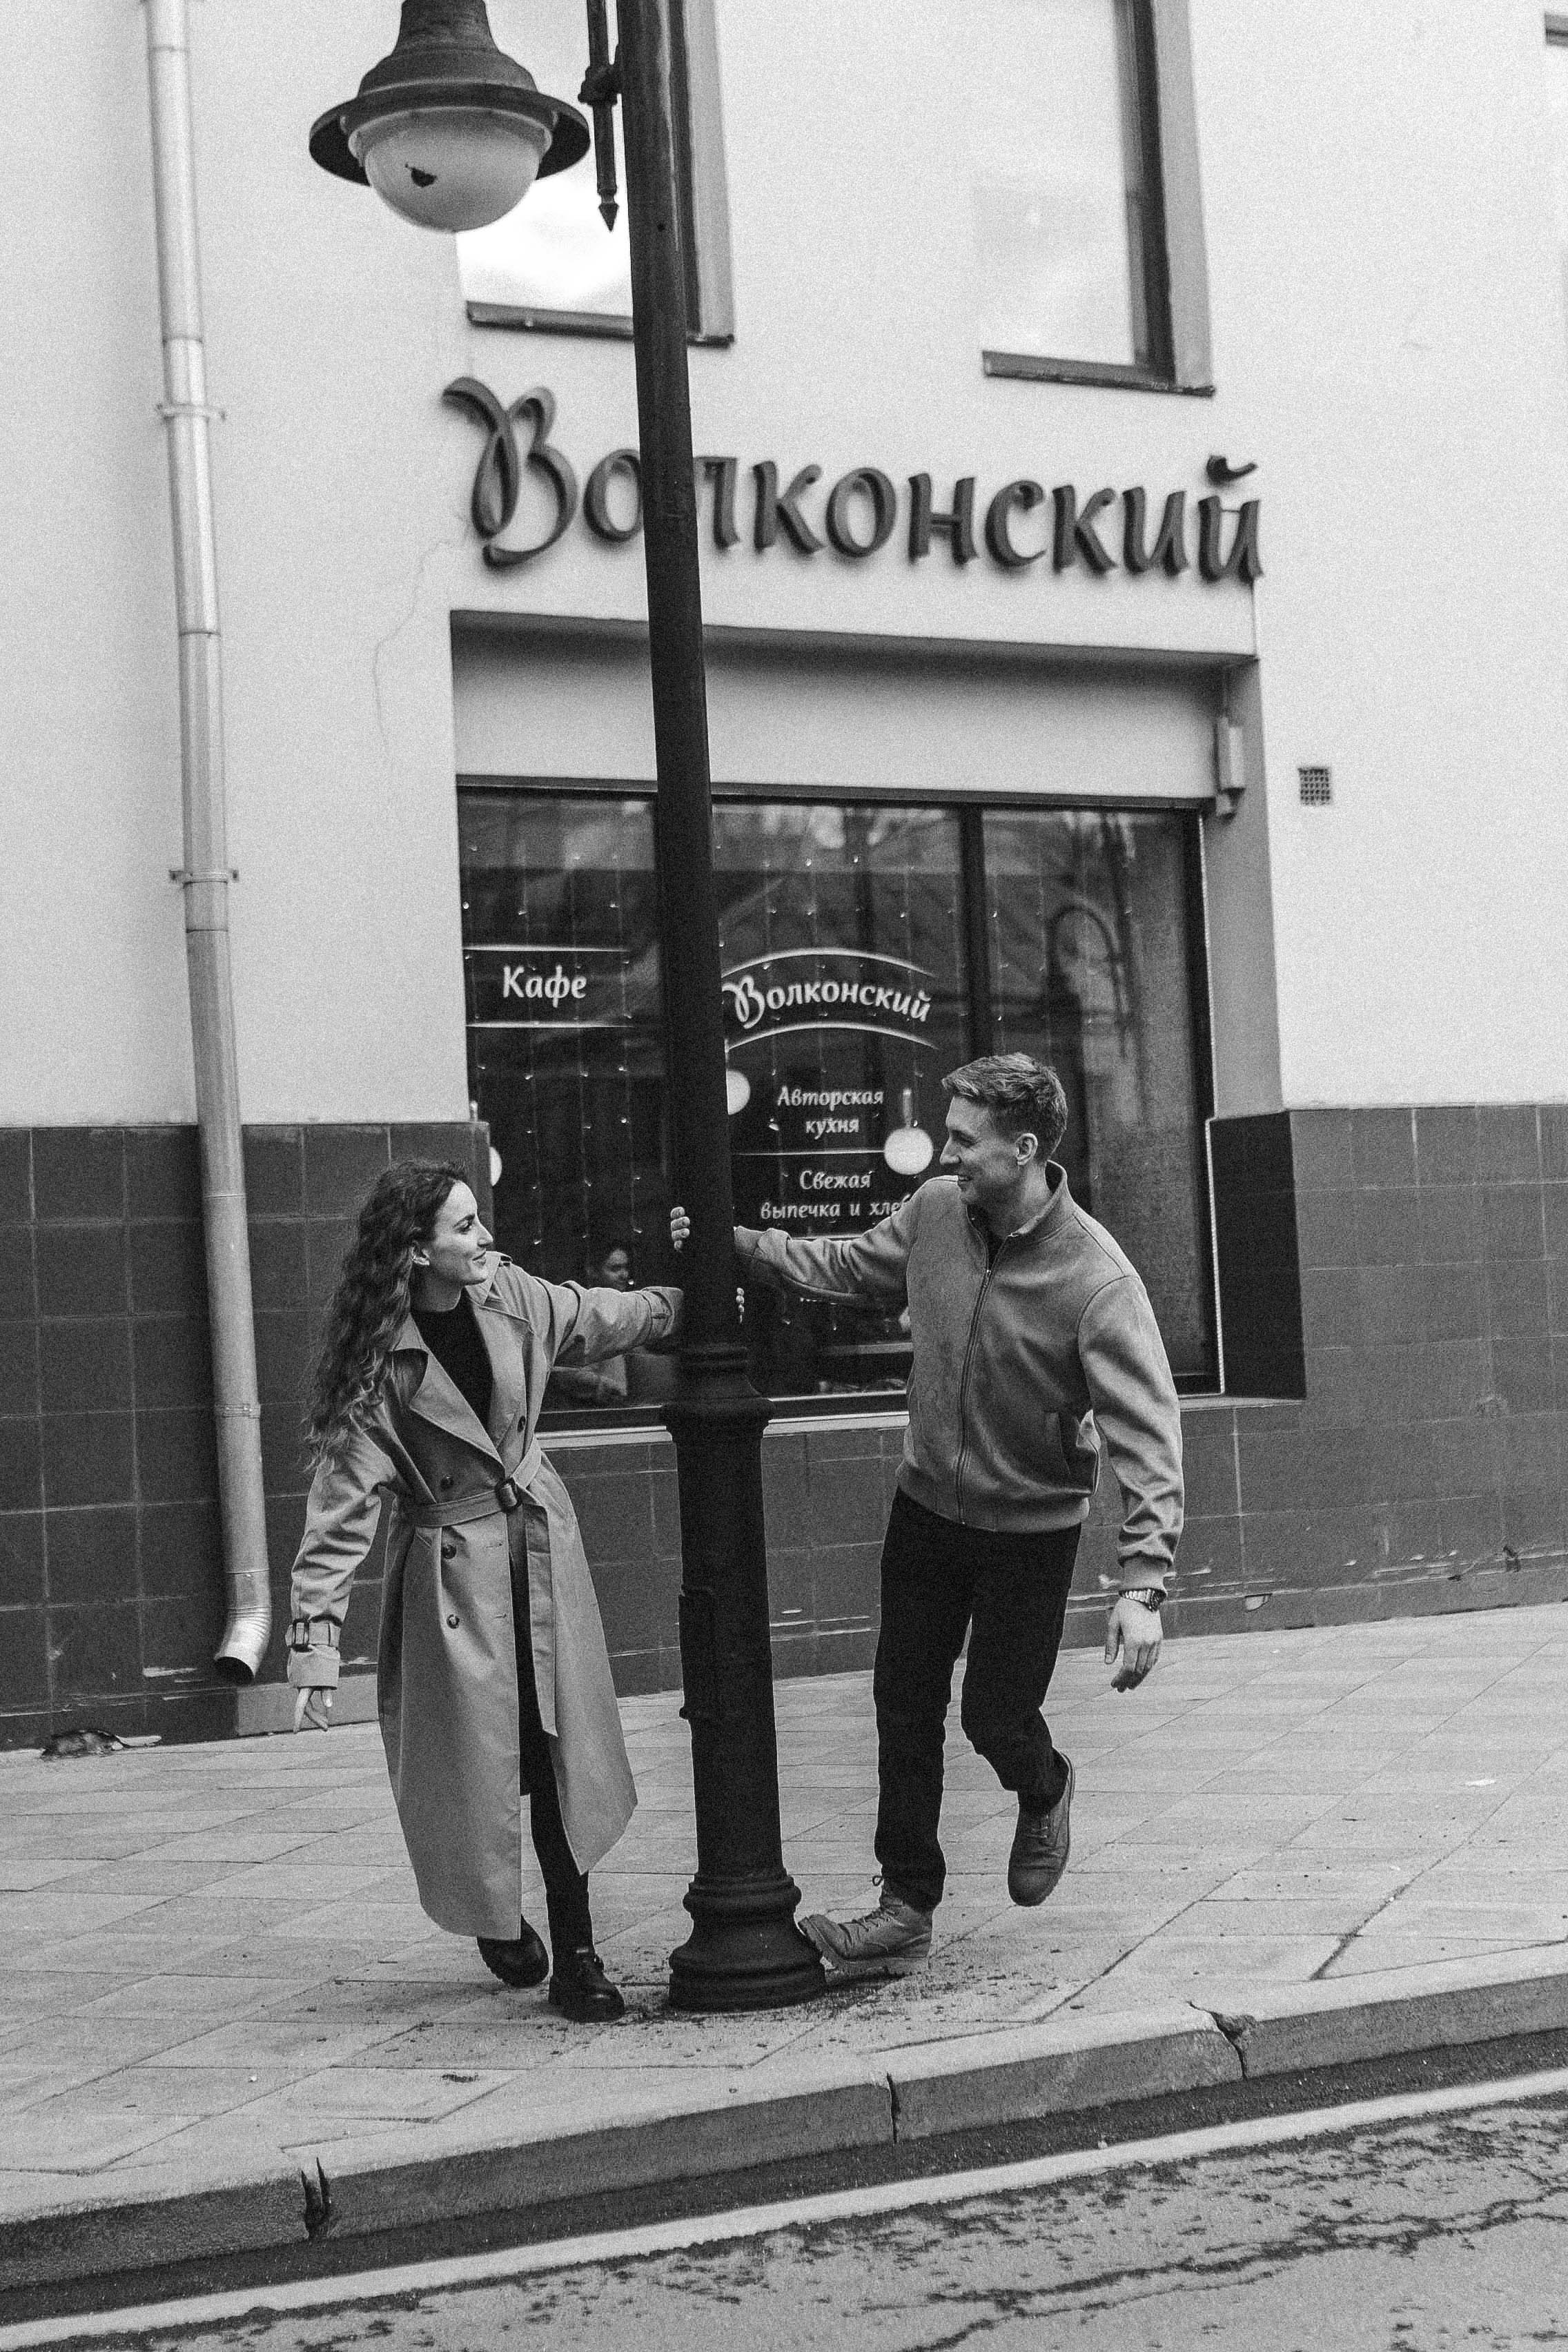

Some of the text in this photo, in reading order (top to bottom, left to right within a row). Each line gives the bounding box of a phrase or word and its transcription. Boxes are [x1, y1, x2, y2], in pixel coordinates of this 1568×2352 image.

[503, 964, 587, 1008] Кафе
[722, 975, 930, 1029] Волконский
[777, 1086, 883, 1111] Авторская
[805, 1117, 859, 1139] кухня
[800, 1170, 871, 1190] Свежая
[761, 1202, 841, 1219] выпечка
[850, 1203, 861, 1217] и
